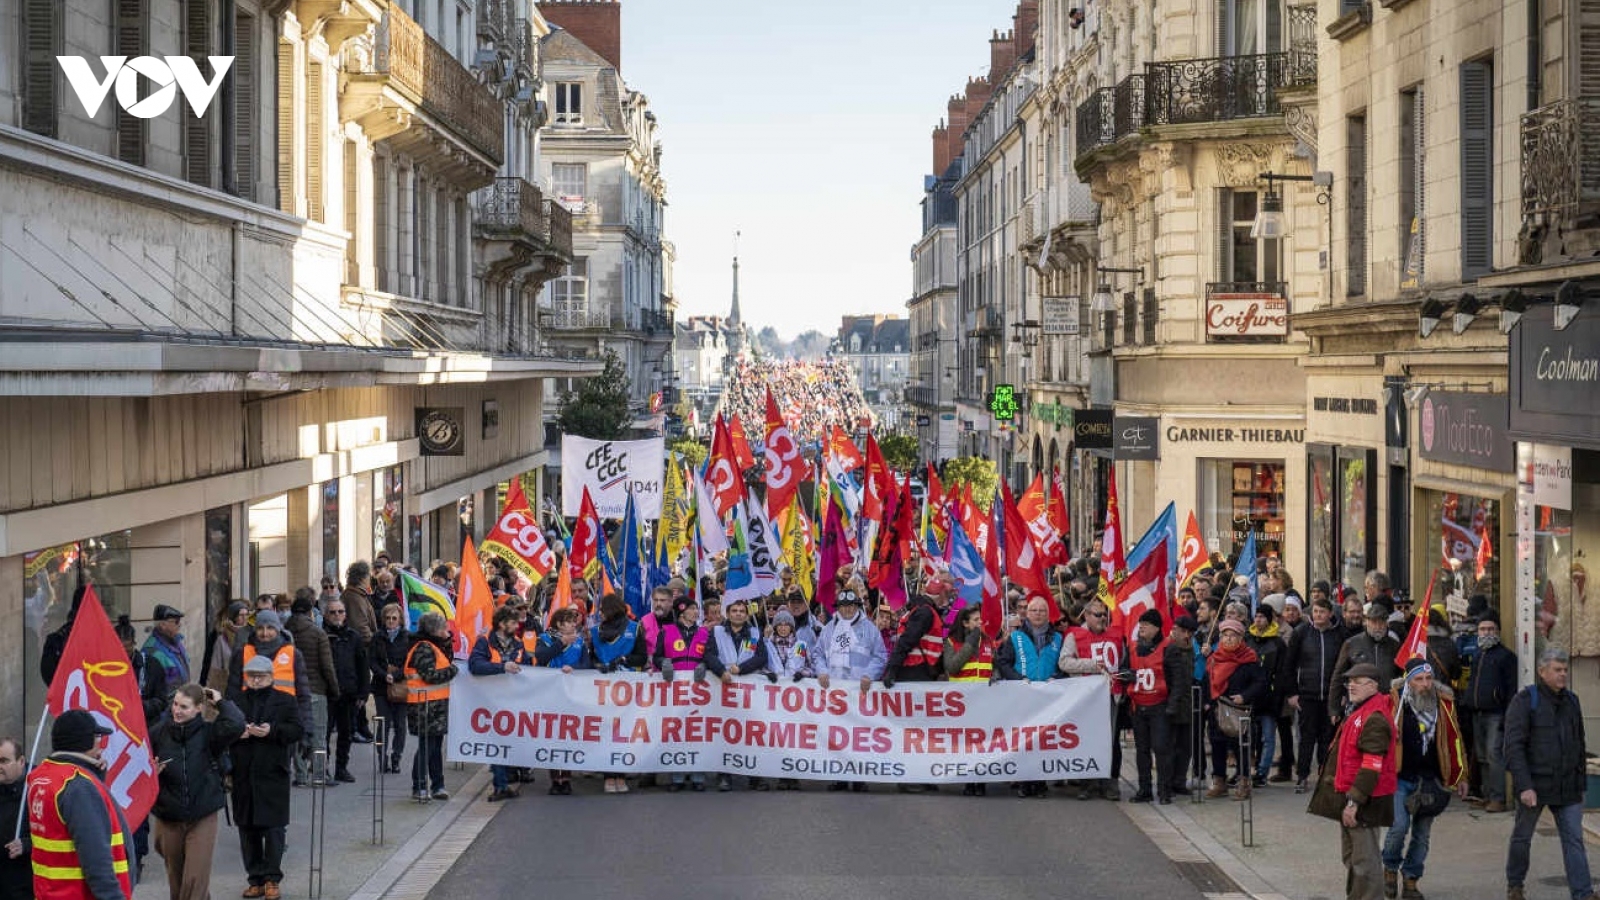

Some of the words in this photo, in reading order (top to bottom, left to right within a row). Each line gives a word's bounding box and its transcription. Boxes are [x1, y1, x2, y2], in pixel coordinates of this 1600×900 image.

[1537, 346, 1598, 381] Coolman
[1166, 425, 1306, 443] GARNIER-THIEBAU
[585, 441, 612, 470] CFE
[597, 452, 627, 482] CGC
[1090, 641, 1119, 674] FO
[1133, 668, 1156, 692] FO
[594, 679, 711, 707] TOUTES
[721, 682, 756, 709] ET
[764, 684, 848, 716] TOUS
[859, 690, 967, 718] UNI-ES
[470, 708, 602, 742] CONTRE
[612, 716, 651, 744] LA
[661, 710, 818, 750] RÉFORME
[827, 726, 893, 754] DES
[903, 723, 1081, 754] RETRAITES
[459, 741, 512, 759] CFDT
[535, 748, 586, 765] CFTC
[610, 752, 636, 766] FO
[660, 751, 699, 766] CGT
[722, 753, 757, 770] FSU
[781, 757, 906, 777] SOLIDAIRES
[930, 761, 1018, 777] CFE-CGC
[1042, 757, 1100, 775] UNSA
